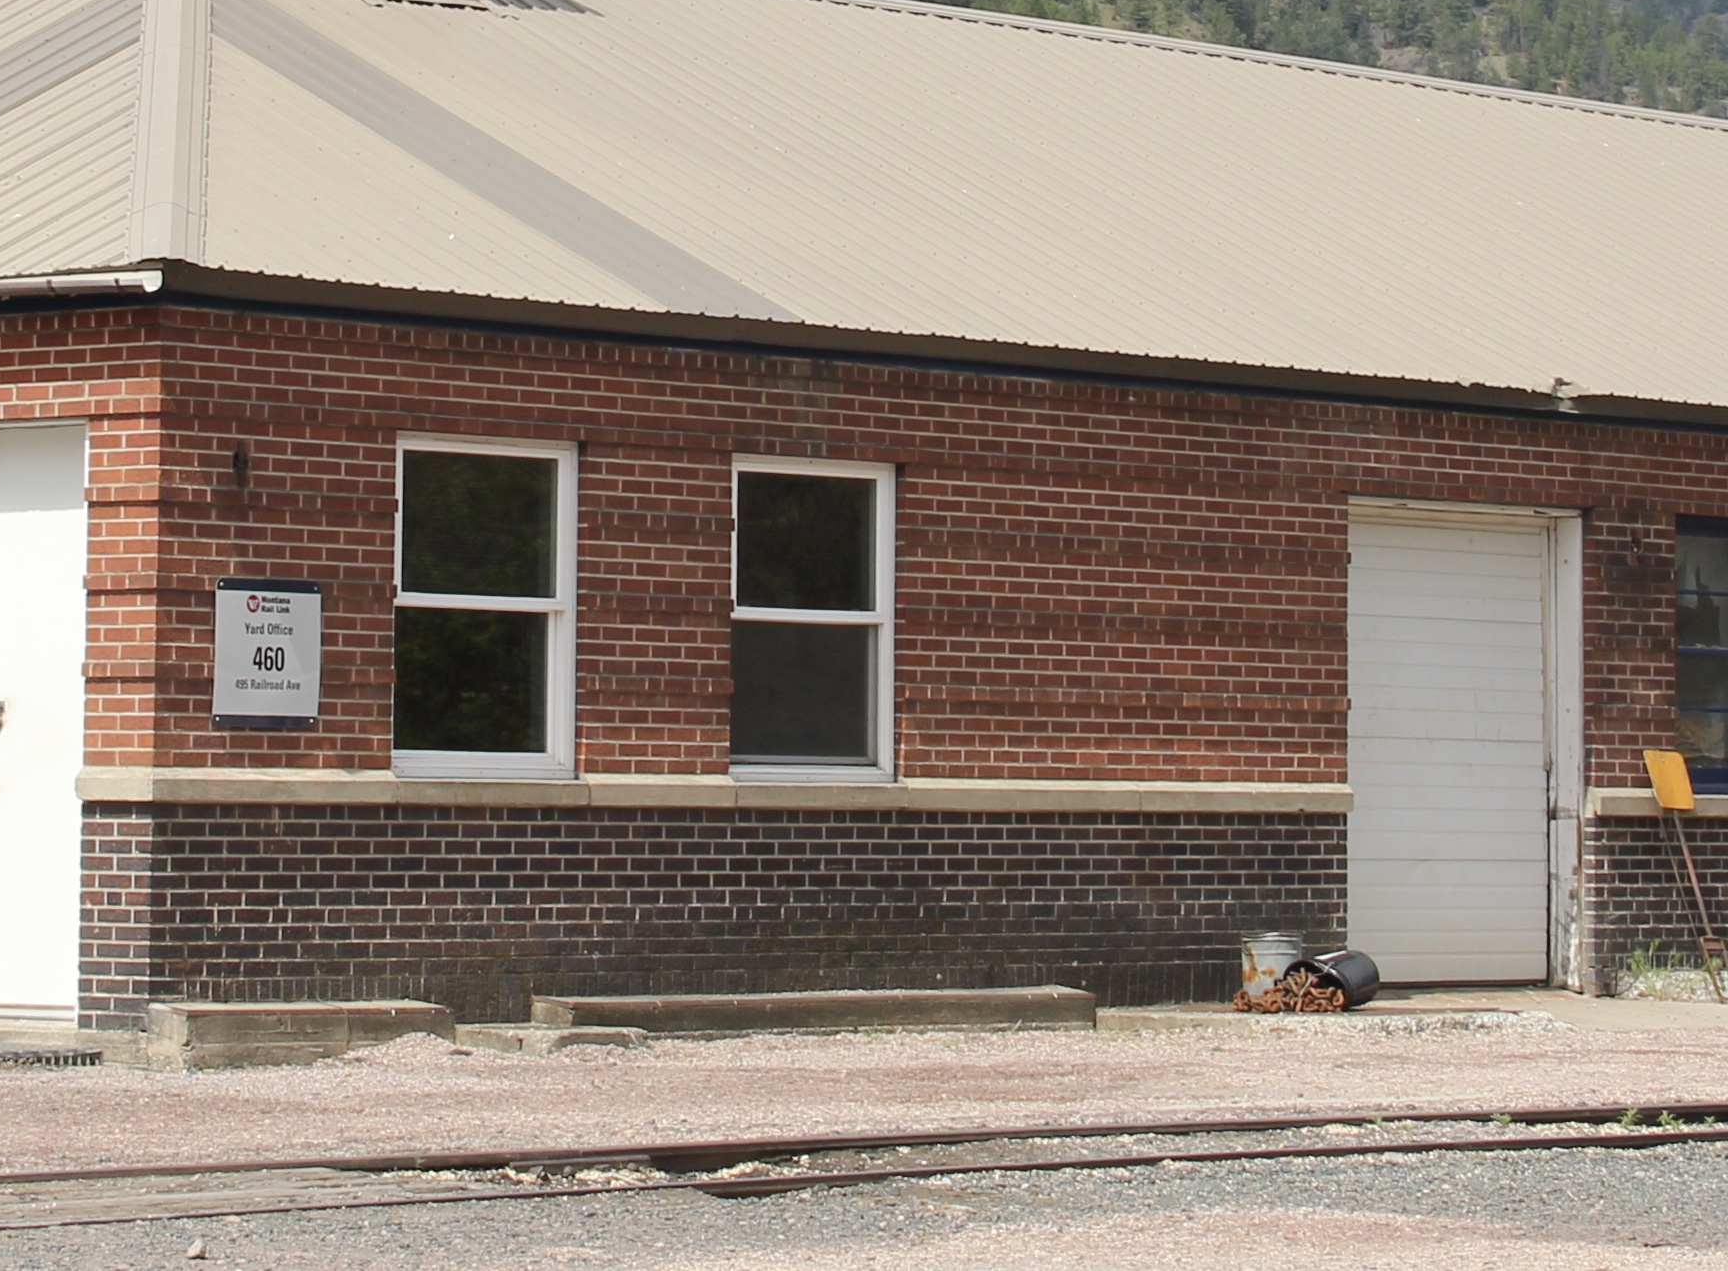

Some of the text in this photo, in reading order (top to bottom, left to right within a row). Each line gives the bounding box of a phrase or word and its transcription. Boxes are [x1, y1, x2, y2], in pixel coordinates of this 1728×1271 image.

[261, 596, 291, 604] Montana
[261, 605, 275, 613] Rail
[245, 622, 294, 635] Yard Office
[253, 646, 285, 671] 460
[235, 679, 301, 690] 495 Railroad Ave
